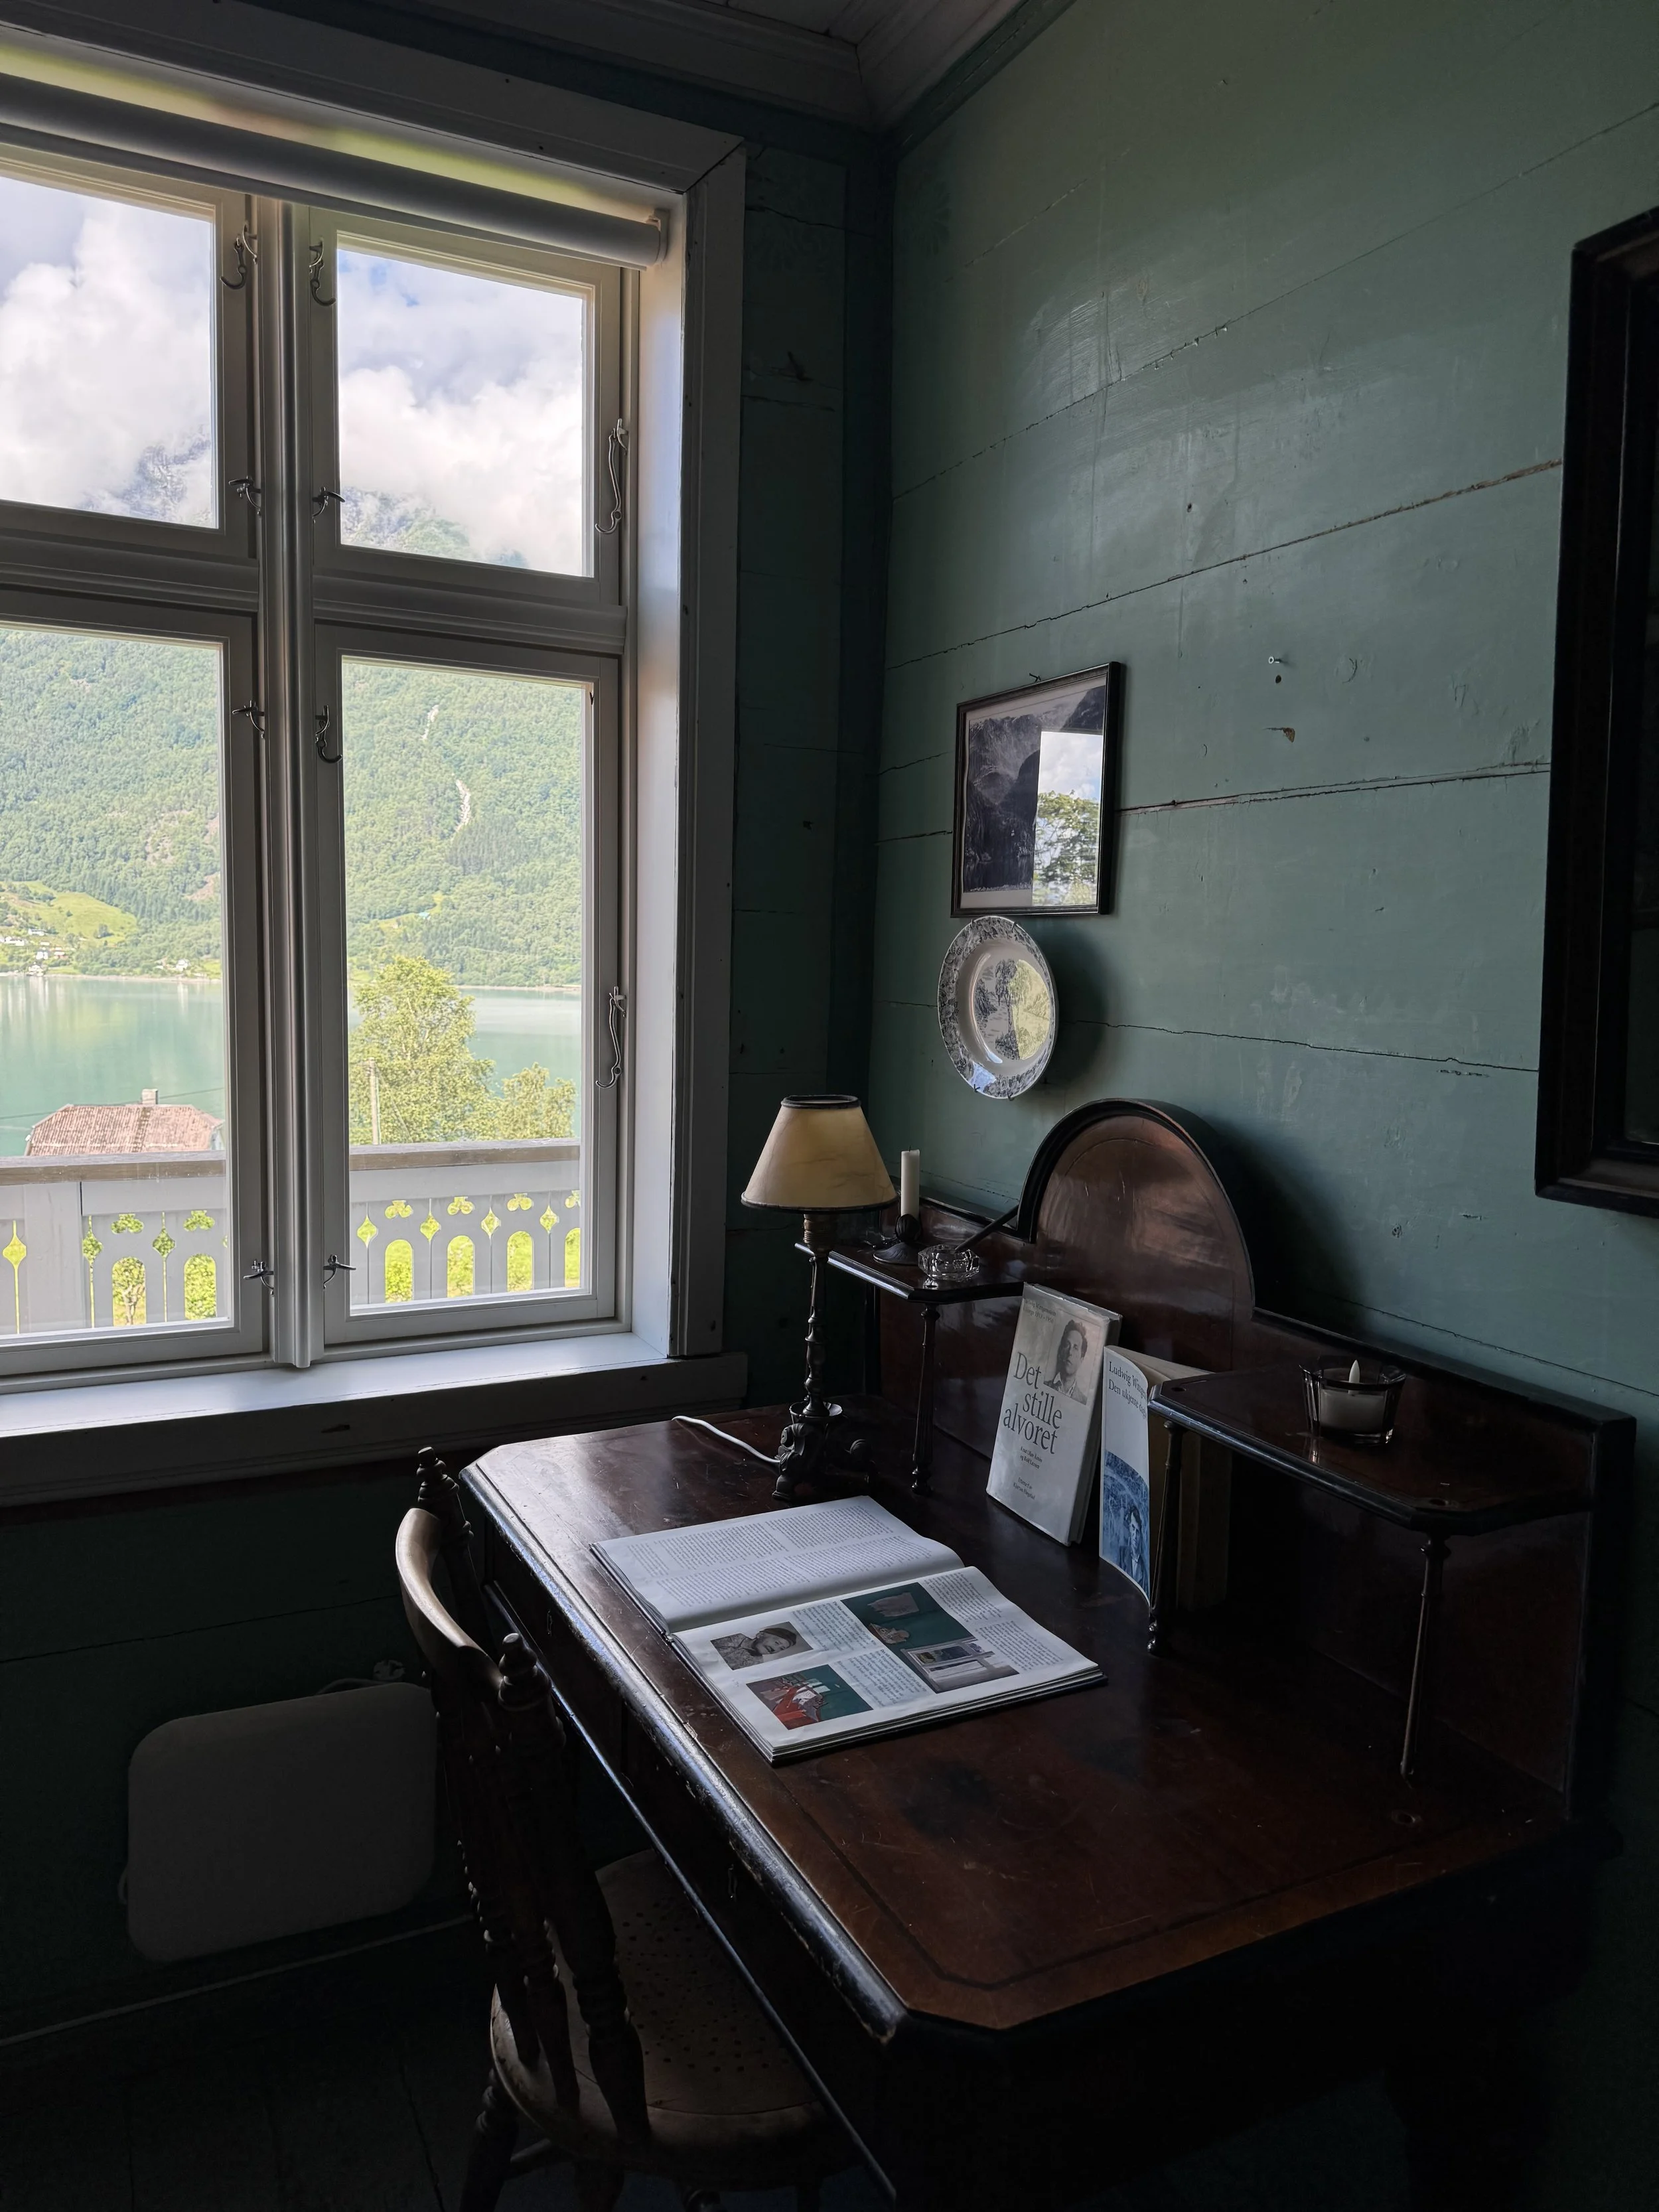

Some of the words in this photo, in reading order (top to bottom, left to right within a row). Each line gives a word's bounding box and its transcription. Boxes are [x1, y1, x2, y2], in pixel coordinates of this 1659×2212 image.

[1013, 1351, 1043, 1389] Det
[1109, 1361, 1131, 1386] Ludwig
[1109, 1379, 1121, 1395] Den
[1003, 1403, 1058, 1454] alvoret
[1022, 1390, 1062, 1430] stille
